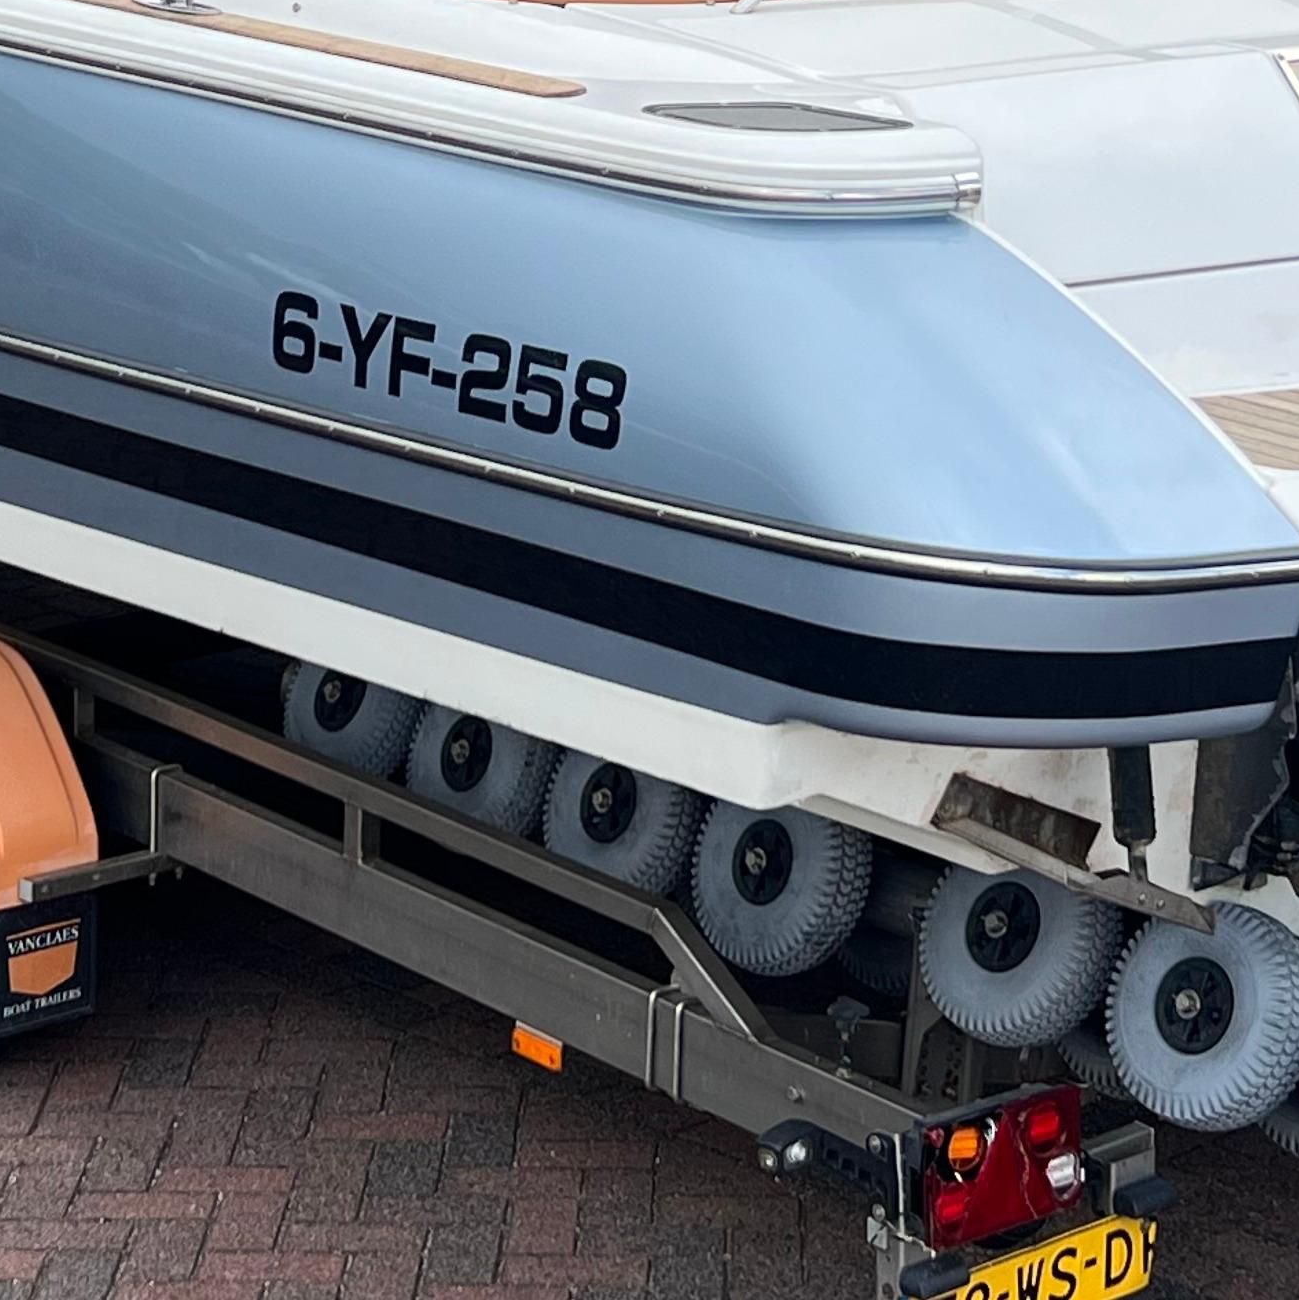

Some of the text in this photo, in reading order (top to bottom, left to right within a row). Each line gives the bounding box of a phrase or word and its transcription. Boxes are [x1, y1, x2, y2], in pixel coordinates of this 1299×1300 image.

[272, 290, 627, 451] 6-YF-258
[7, 925, 79, 955] VANCLAES
[3, 986, 81, 1018] BOAT TRAILERS
